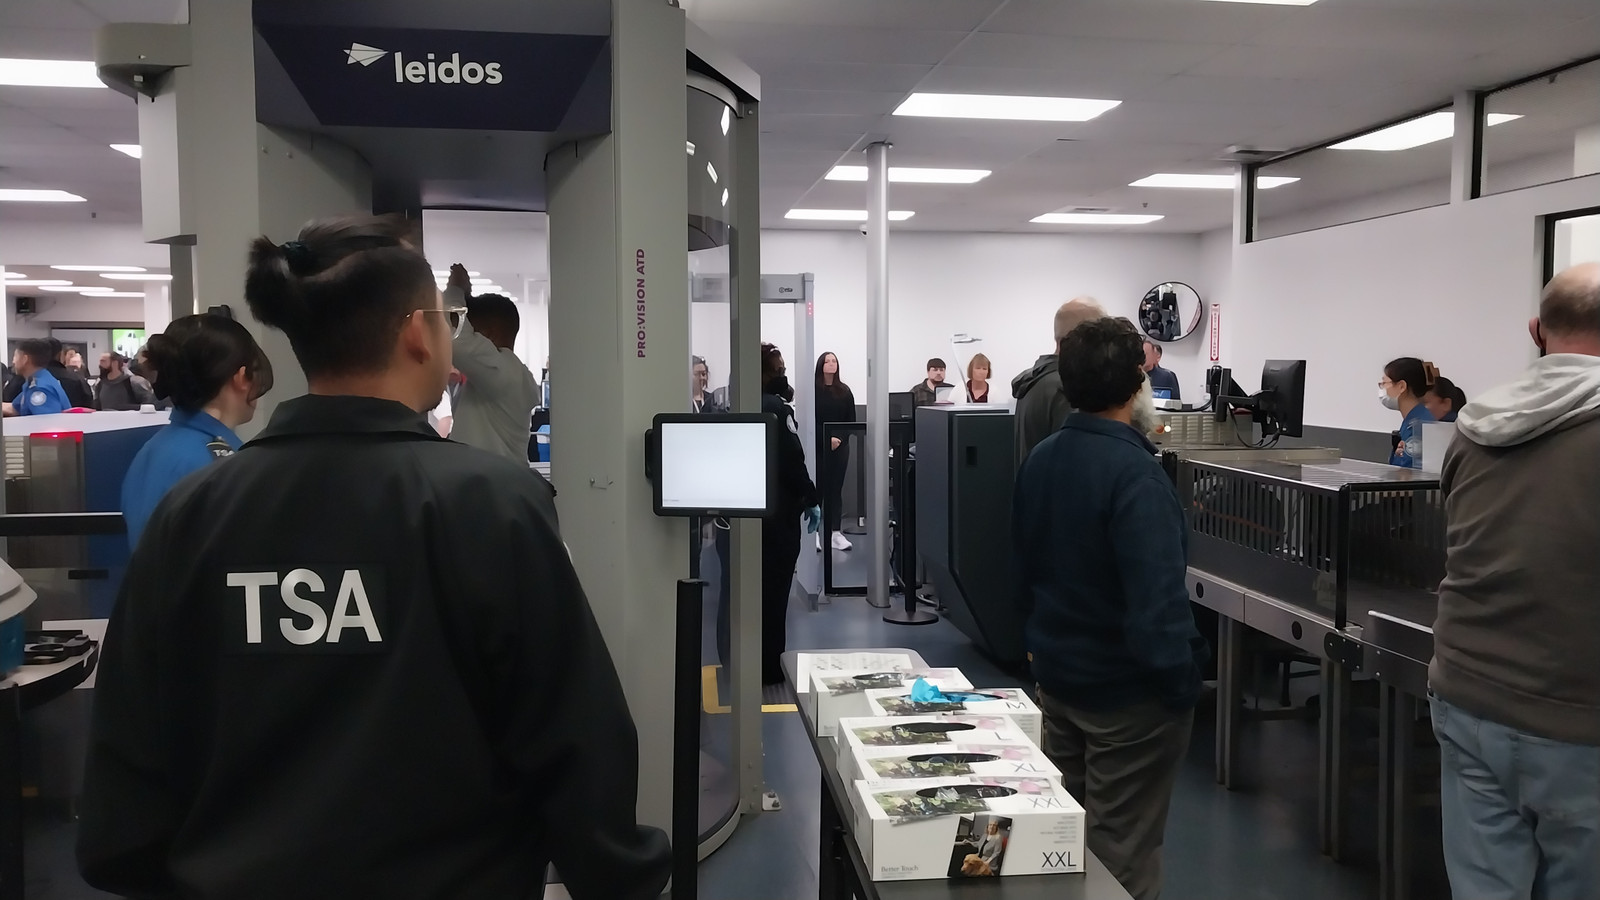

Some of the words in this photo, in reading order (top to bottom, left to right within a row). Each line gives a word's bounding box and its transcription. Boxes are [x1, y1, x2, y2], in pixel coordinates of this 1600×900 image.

[394, 51, 503, 85] leidos
[636, 248, 645, 275] ATD
[636, 278, 646, 358] PRO:VISION
[226, 568, 383, 645] TSA
[1005, 701, 1028, 710] M
[994, 731, 1014, 741] L
[1010, 763, 1047, 773] XL
[1027, 797, 1071, 809] XXL
[1041, 851, 1077, 868] XXL
[901, 864, 919, 872] Touch
